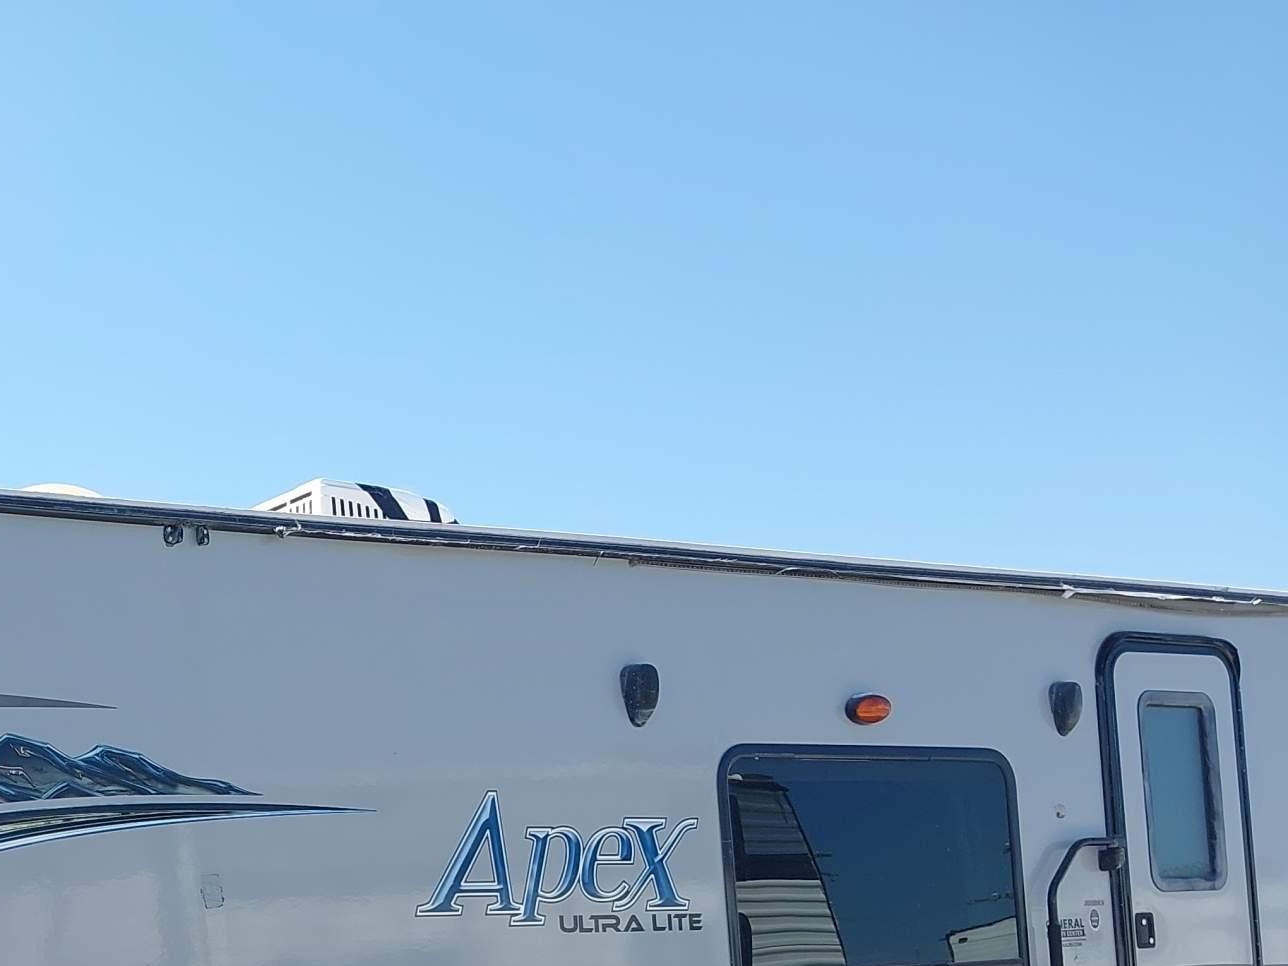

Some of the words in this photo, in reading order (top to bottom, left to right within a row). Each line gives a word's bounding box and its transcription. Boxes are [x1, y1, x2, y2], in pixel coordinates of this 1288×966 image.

[415, 790, 699, 927] Apex
[559, 914, 645, 933] ULTRA
[653, 913, 703, 931] LITE
[1046, 918, 1085, 929] ERAL
